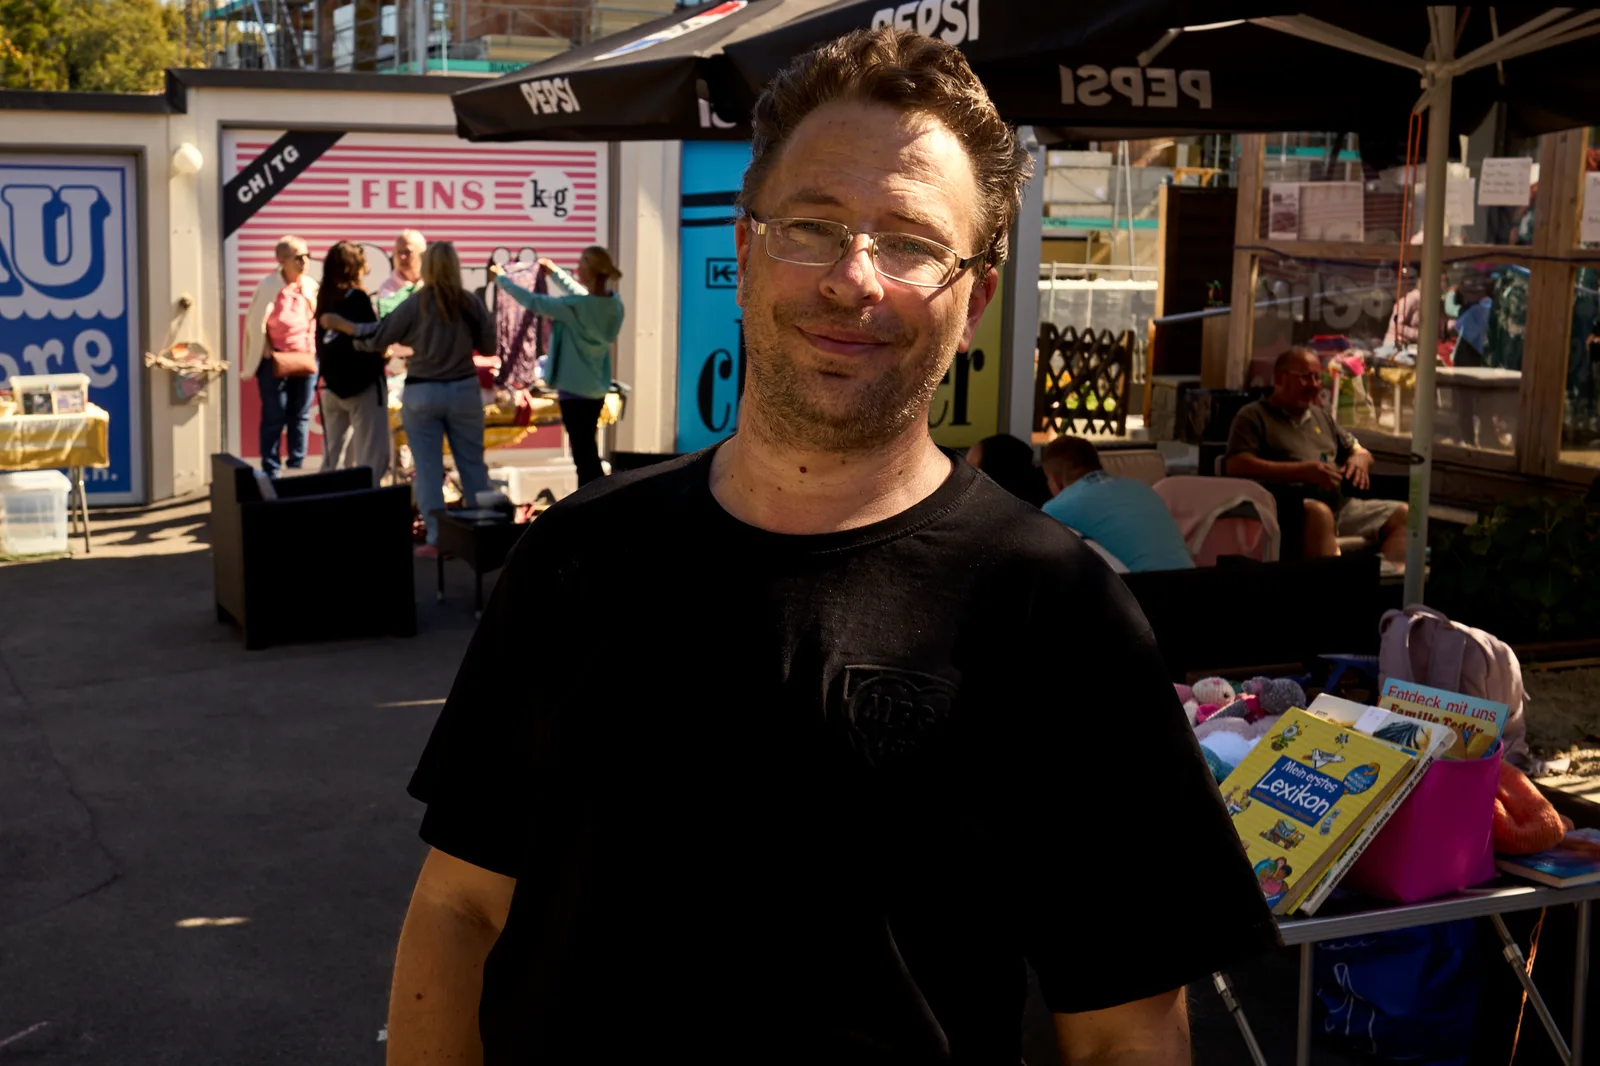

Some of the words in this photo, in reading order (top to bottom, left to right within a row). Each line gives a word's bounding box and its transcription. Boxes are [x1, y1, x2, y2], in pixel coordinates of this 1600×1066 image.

[520, 77, 581, 115] PEPSI
[361, 179, 486, 211] FEINS
[1388, 685, 1441, 710] Entdeck
[1445, 701, 1468, 716] mit
[1471, 708, 1497, 722] uns
[1390, 703, 1440, 723] Familie
[1256, 767, 1330, 817] Lexikon
[1281, 760, 1307, 779] Mein
[1305, 773, 1338, 794] erstes
